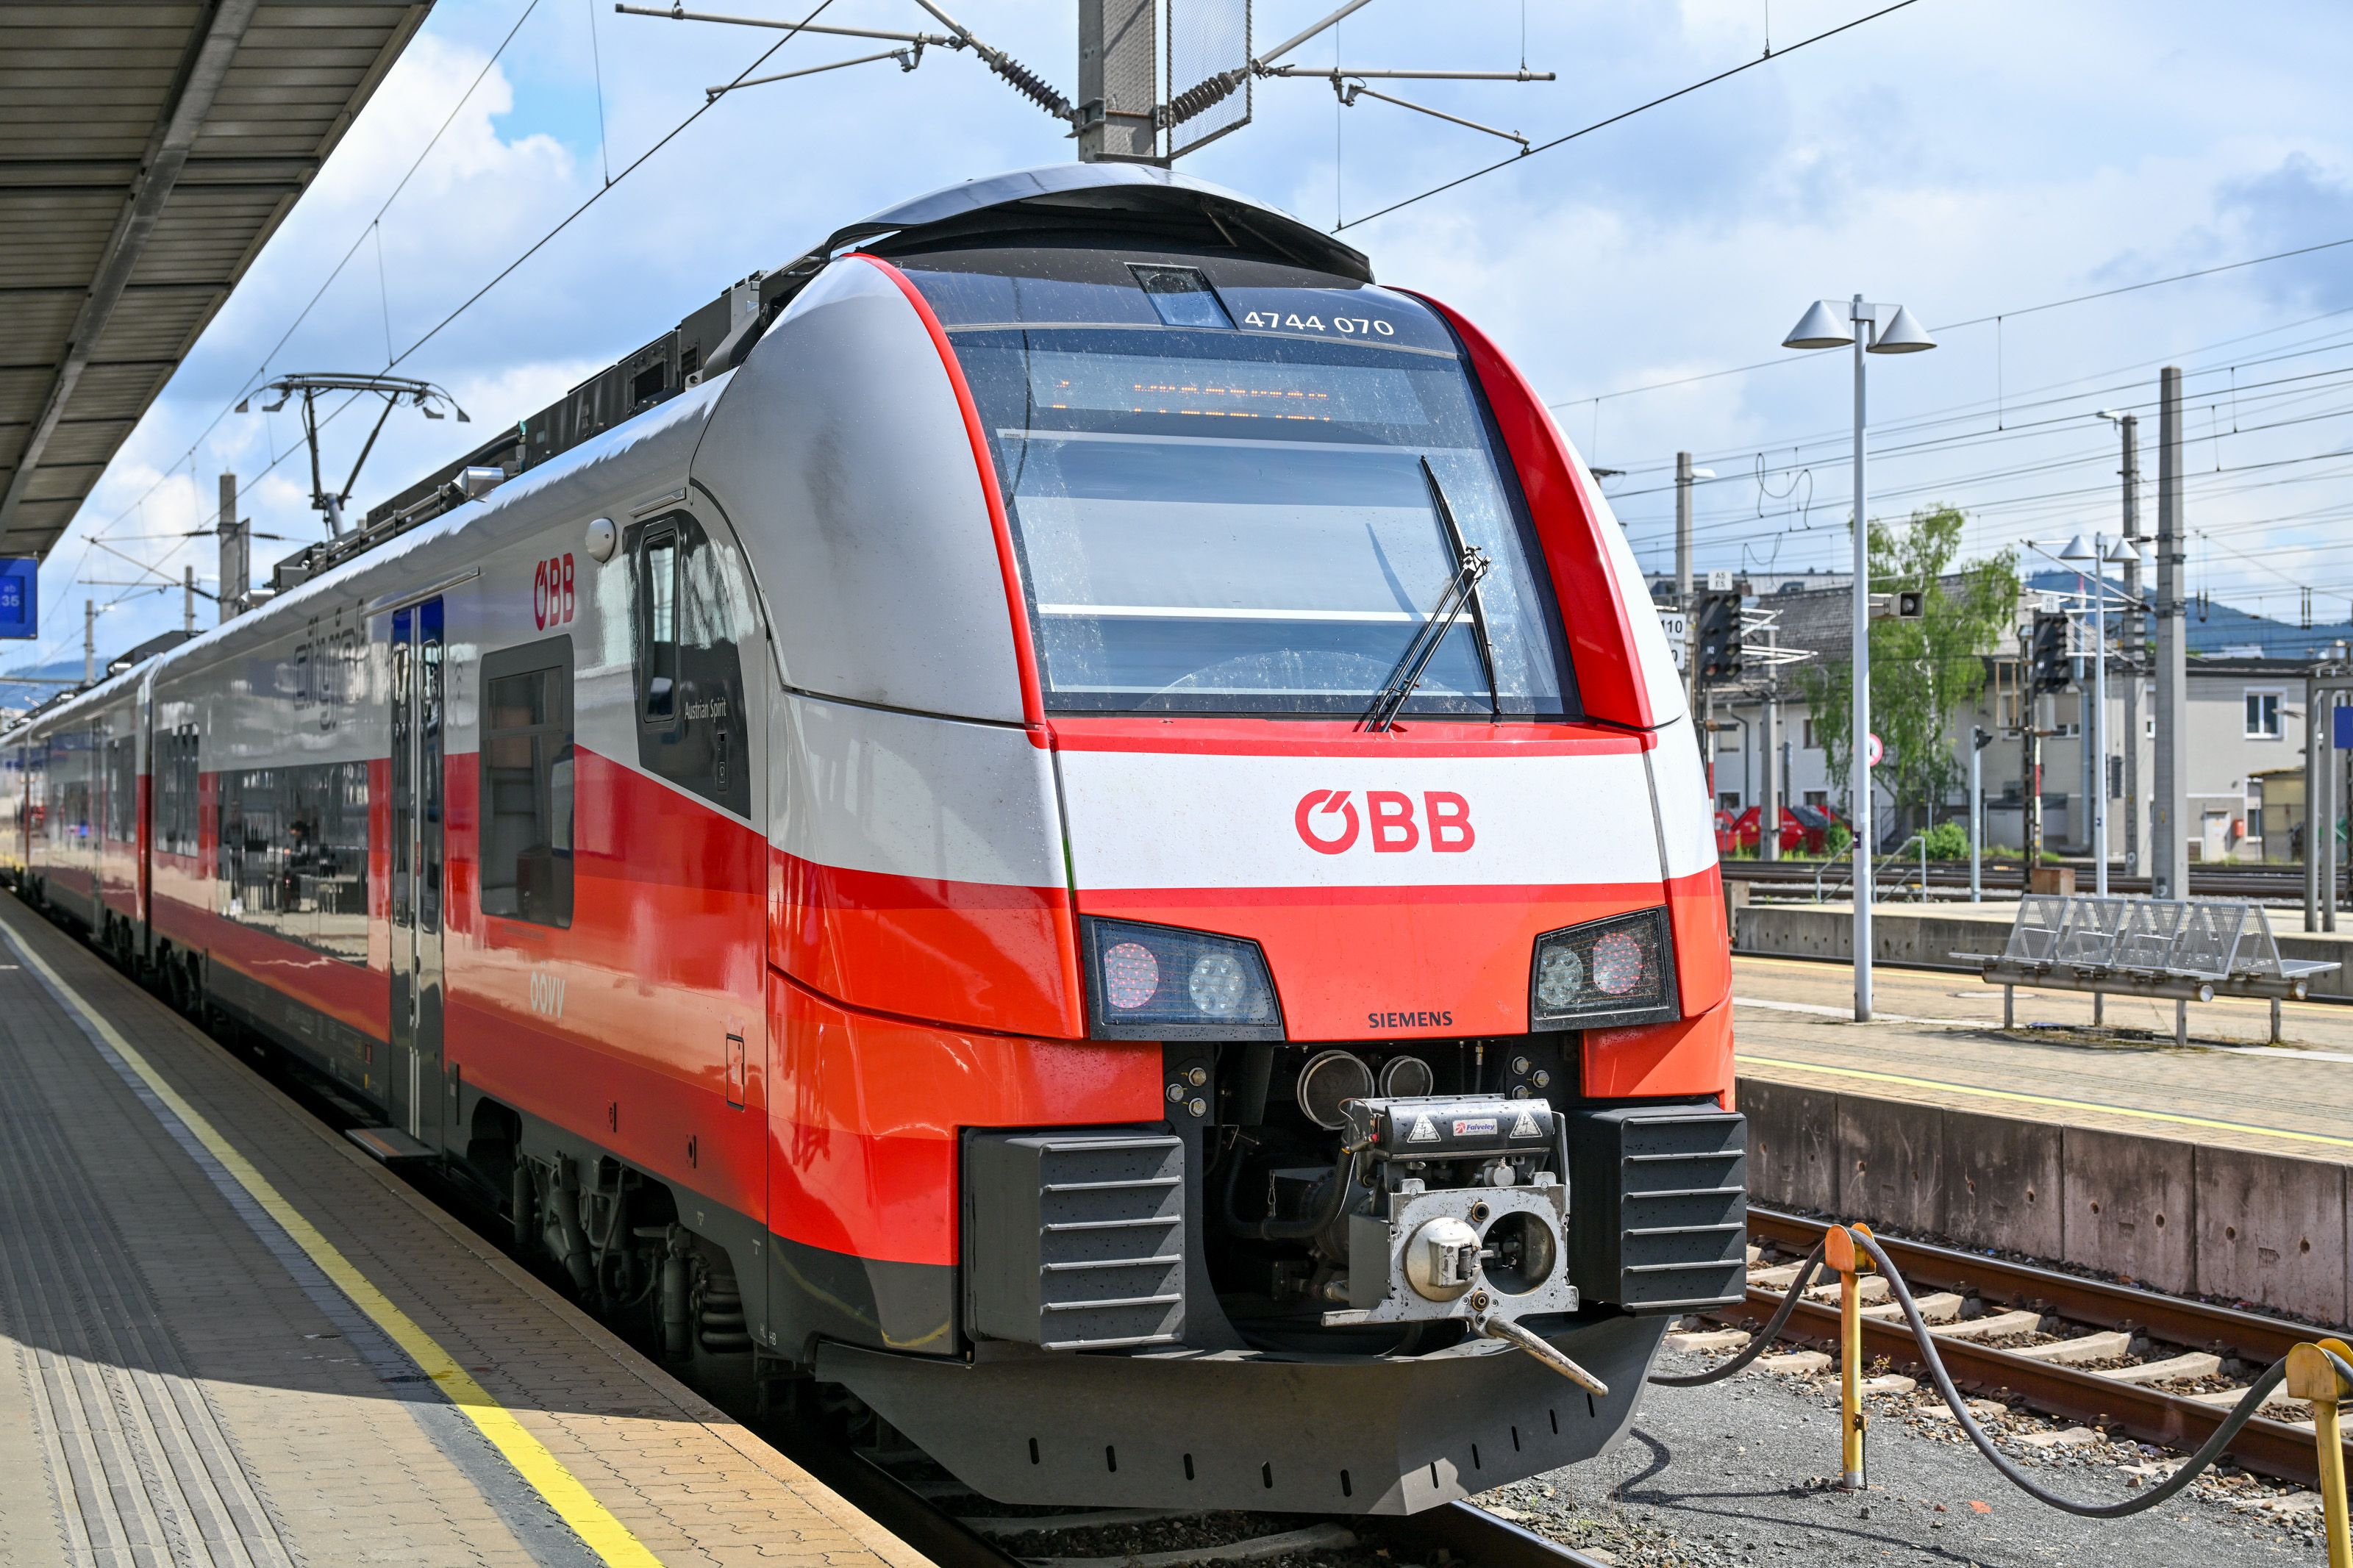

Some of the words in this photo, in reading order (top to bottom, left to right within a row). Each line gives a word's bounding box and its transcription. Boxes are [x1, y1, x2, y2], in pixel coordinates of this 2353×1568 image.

[1244, 311, 1326, 331] 4744
[1333, 317, 1394, 336] 070
[534, 552, 574, 631] ÖBB
[685, 699, 709, 720] Austrian
[710, 696, 726, 723] Spirit
[1295, 789, 1475, 855] ÖBB
[530, 960, 565, 1020] OÖVV
[1368, 1011, 1453, 1028] SIEMENS
